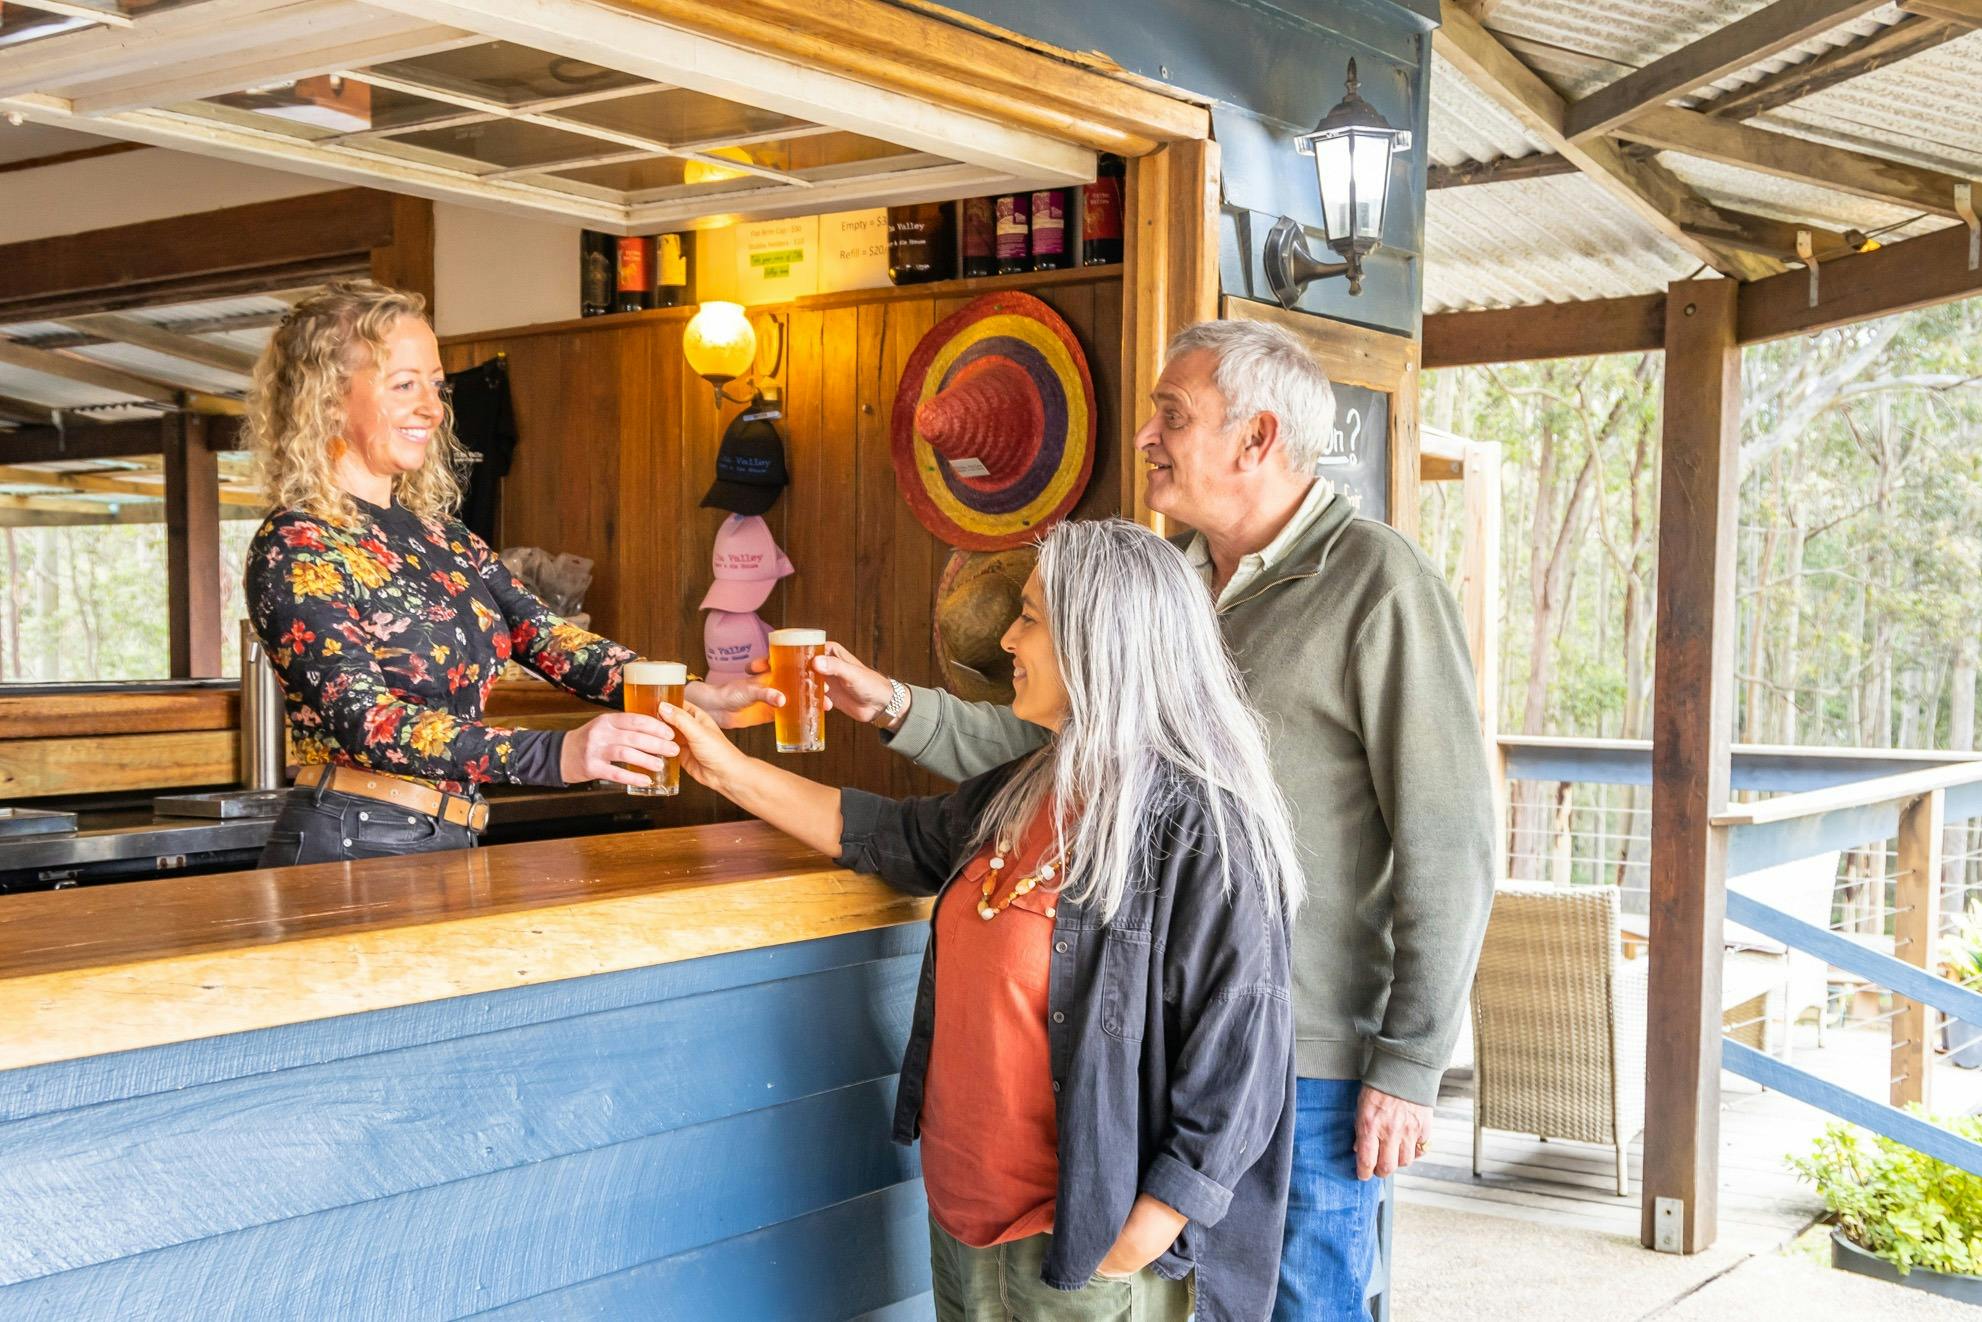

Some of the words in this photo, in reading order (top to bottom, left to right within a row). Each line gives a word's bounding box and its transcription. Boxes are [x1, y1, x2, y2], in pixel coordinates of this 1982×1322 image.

[841, 219, 866, 232] Empty
[896, 222, 925, 232] Valley
[840, 247, 860, 260] Refill
[736, 455, 770, 468] Valley
[728, 553, 764, 563] Valley
[717, 643, 752, 655] Valley
